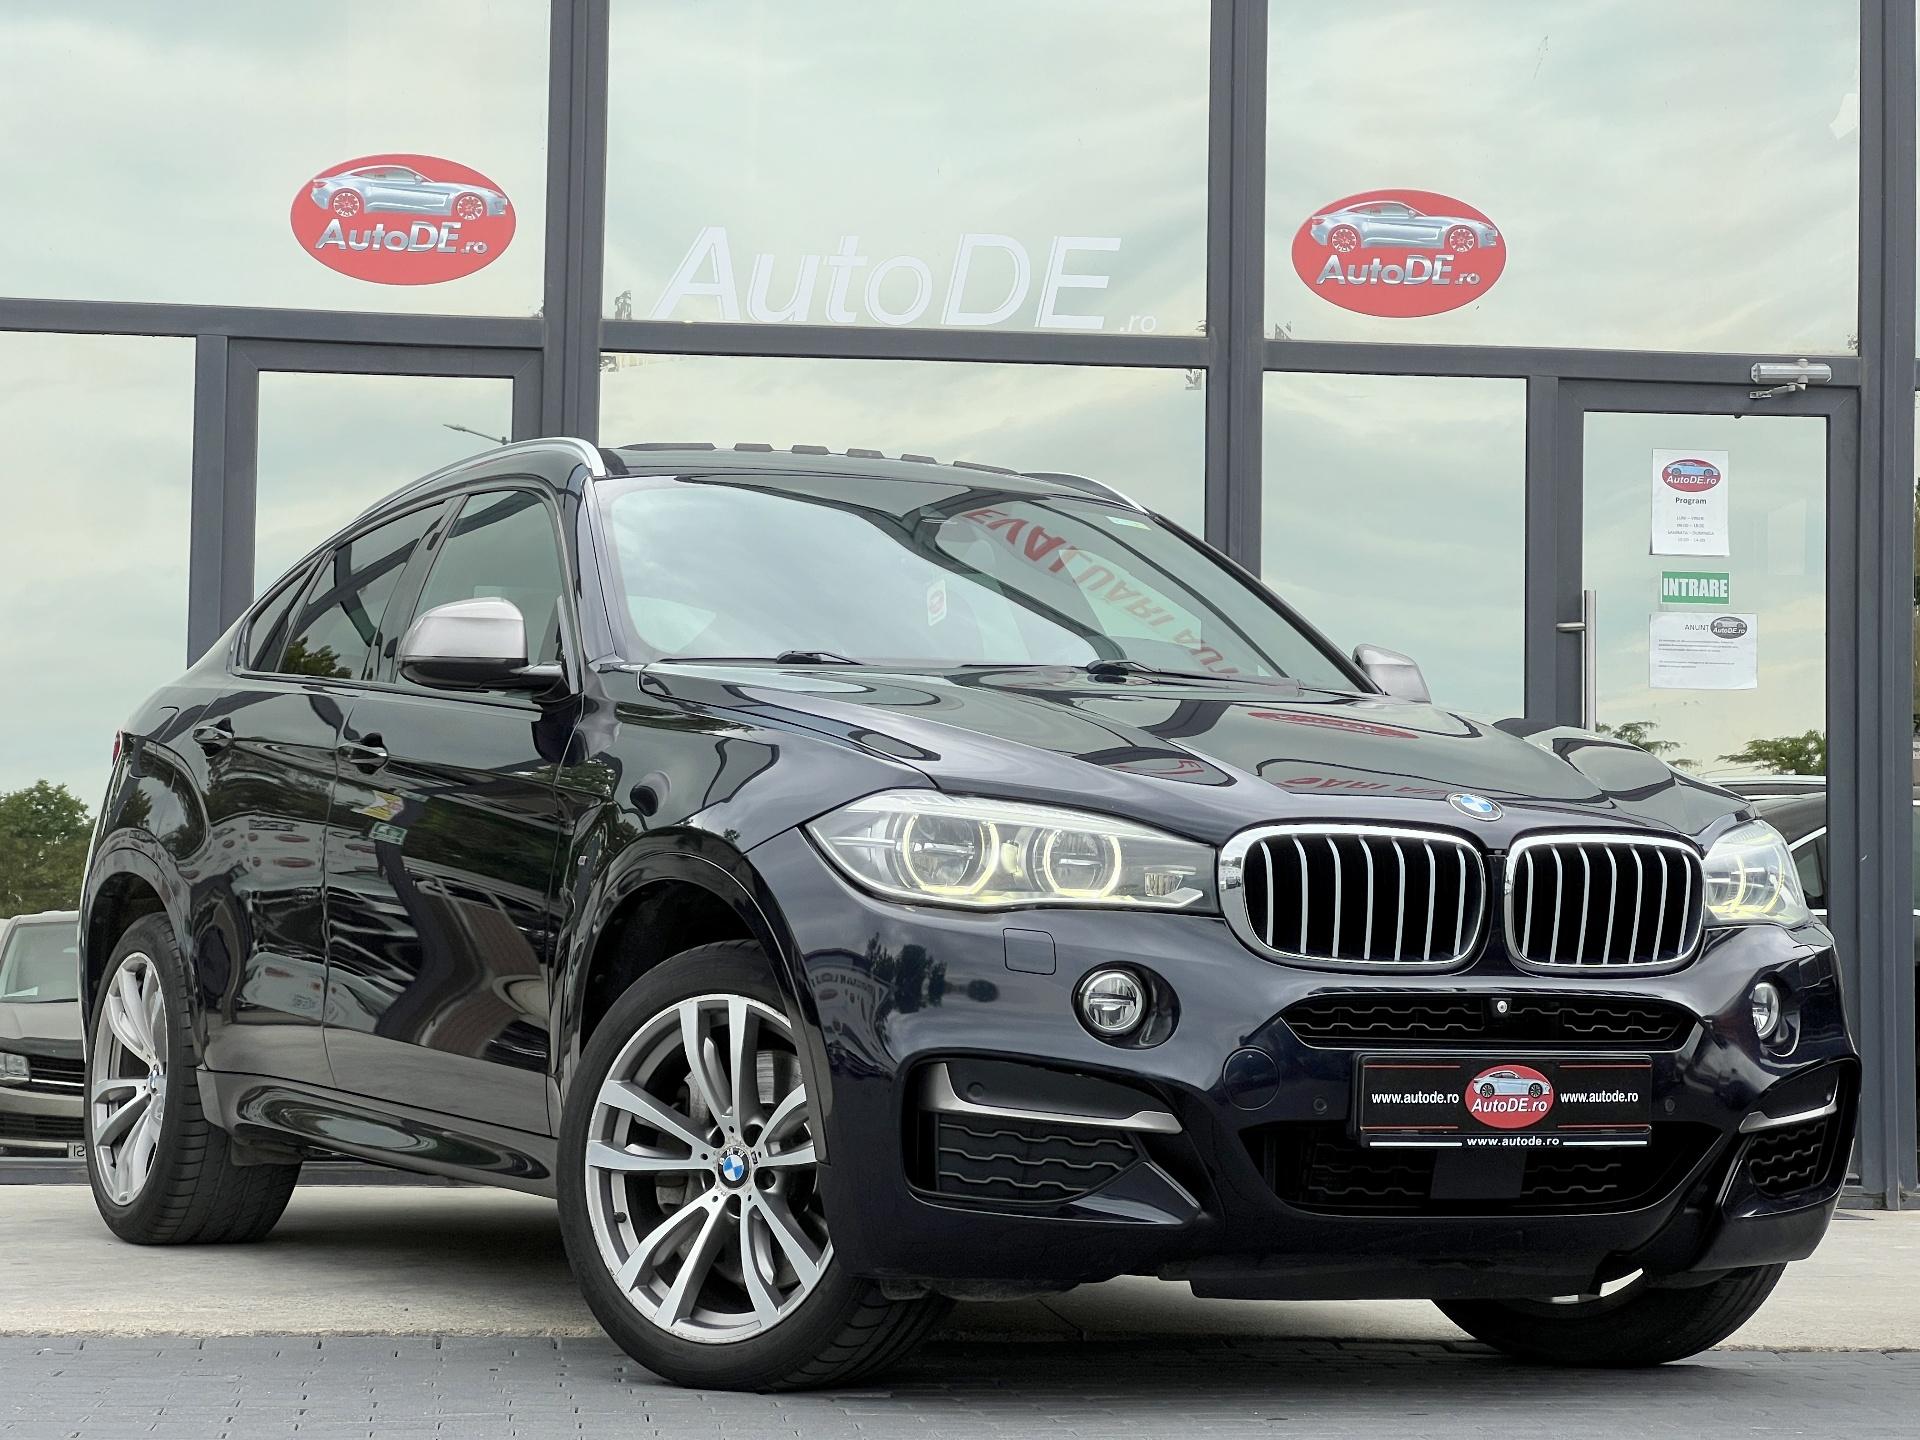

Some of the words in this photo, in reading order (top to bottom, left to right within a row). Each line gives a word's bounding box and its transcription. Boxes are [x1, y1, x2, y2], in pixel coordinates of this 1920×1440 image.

[315, 218, 487, 254] AutoDE.ro
[1315, 254, 1481, 285] AutoDE.ro
[1667, 475, 1717, 485] AutoDE.ro
[1675, 497, 1707, 505] Program
[1663, 577, 1728, 598] INTRARE
[1371, 1092, 1460, 1104] www.autode.ro
[1560, 1091, 1639, 1103] www.autode.ro
[1471, 1097, 1548, 1113] AutoDE.ro
[1466, 1136, 1560, 1147] www.autode.ro
